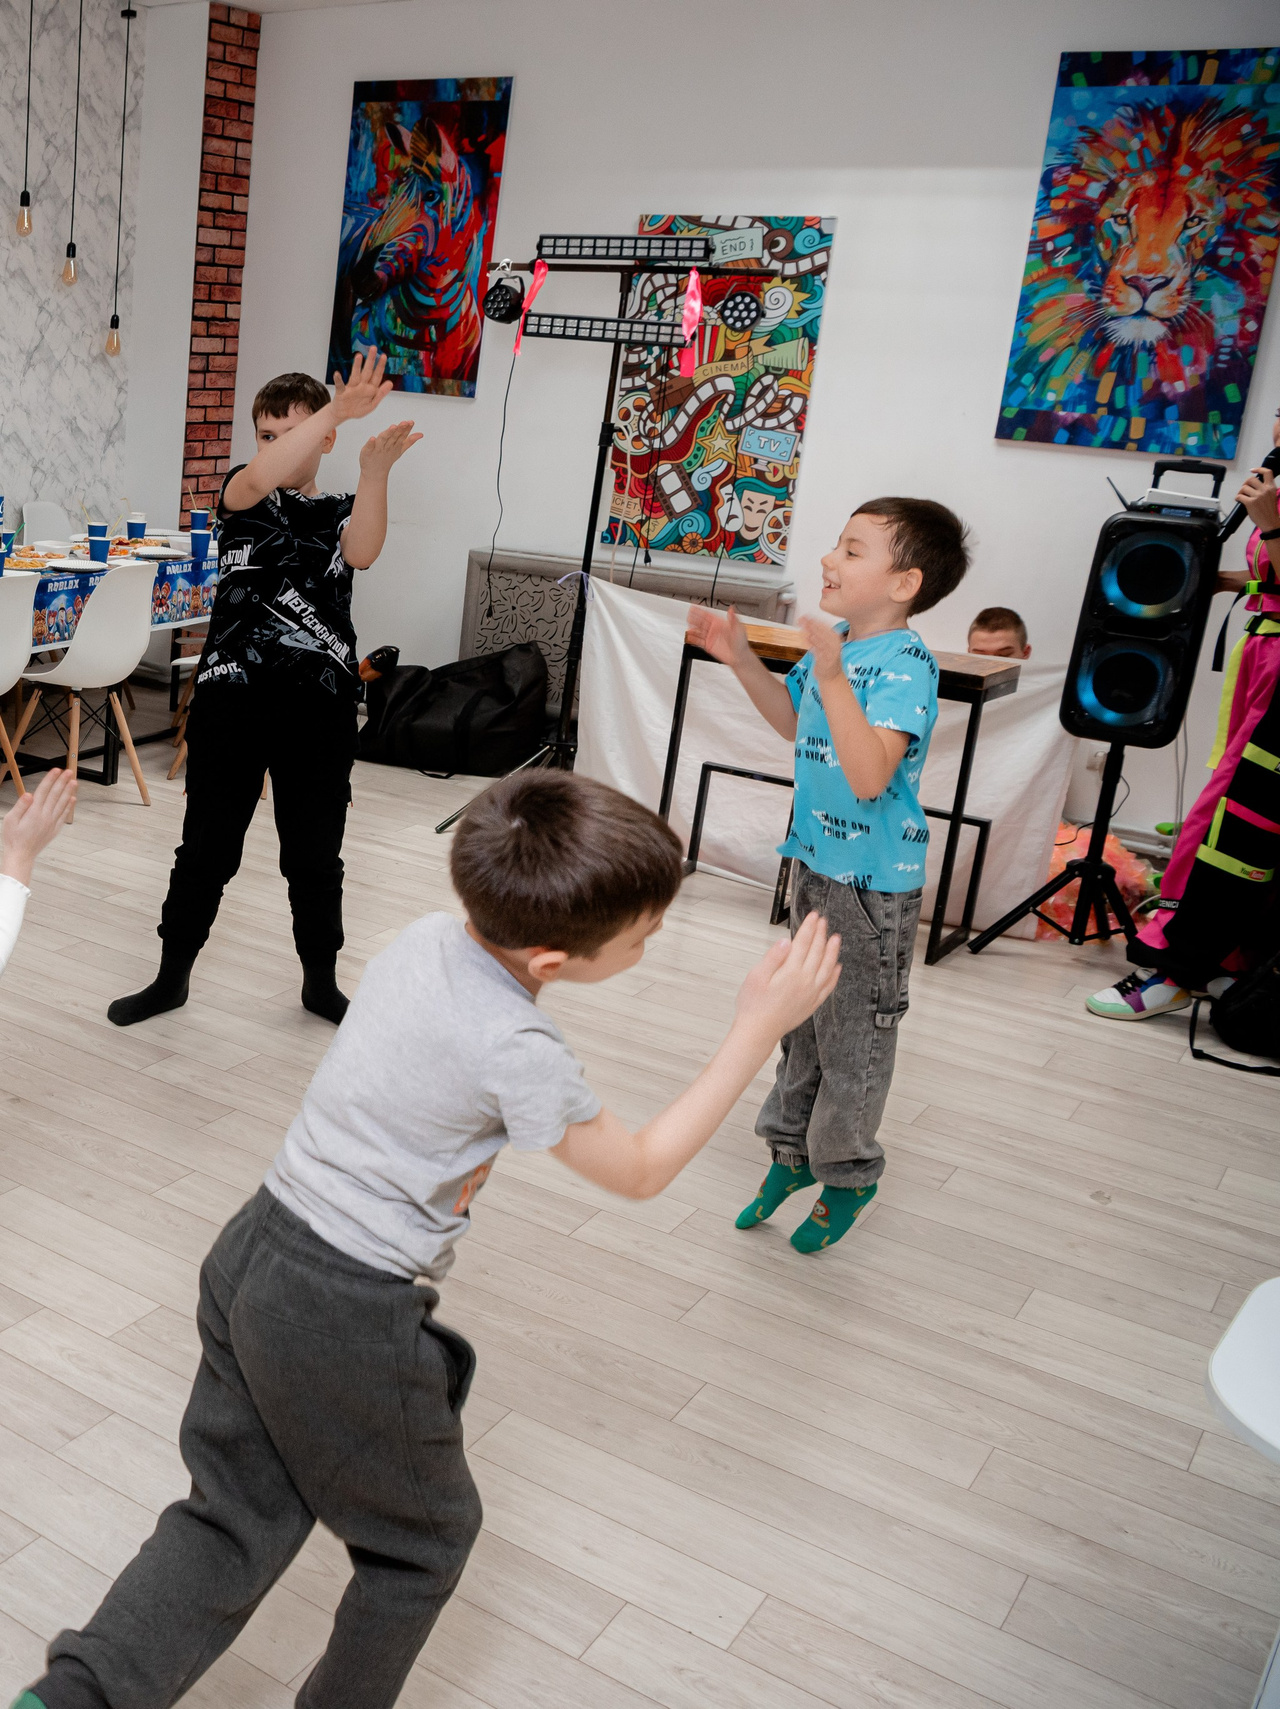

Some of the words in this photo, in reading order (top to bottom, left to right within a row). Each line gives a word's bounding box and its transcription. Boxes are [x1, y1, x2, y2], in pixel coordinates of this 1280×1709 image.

[721, 241, 747, 256] END
[702, 361, 748, 377] CINEMA
[758, 436, 781, 452] TV
[202, 560, 218, 571] ROBL
[47, 579, 80, 593] ROBLOX
[277, 587, 315, 617] NEXT
[302, 614, 350, 661] GENERATION
[213, 664, 228, 676] DO
[821, 812, 847, 828] Make
